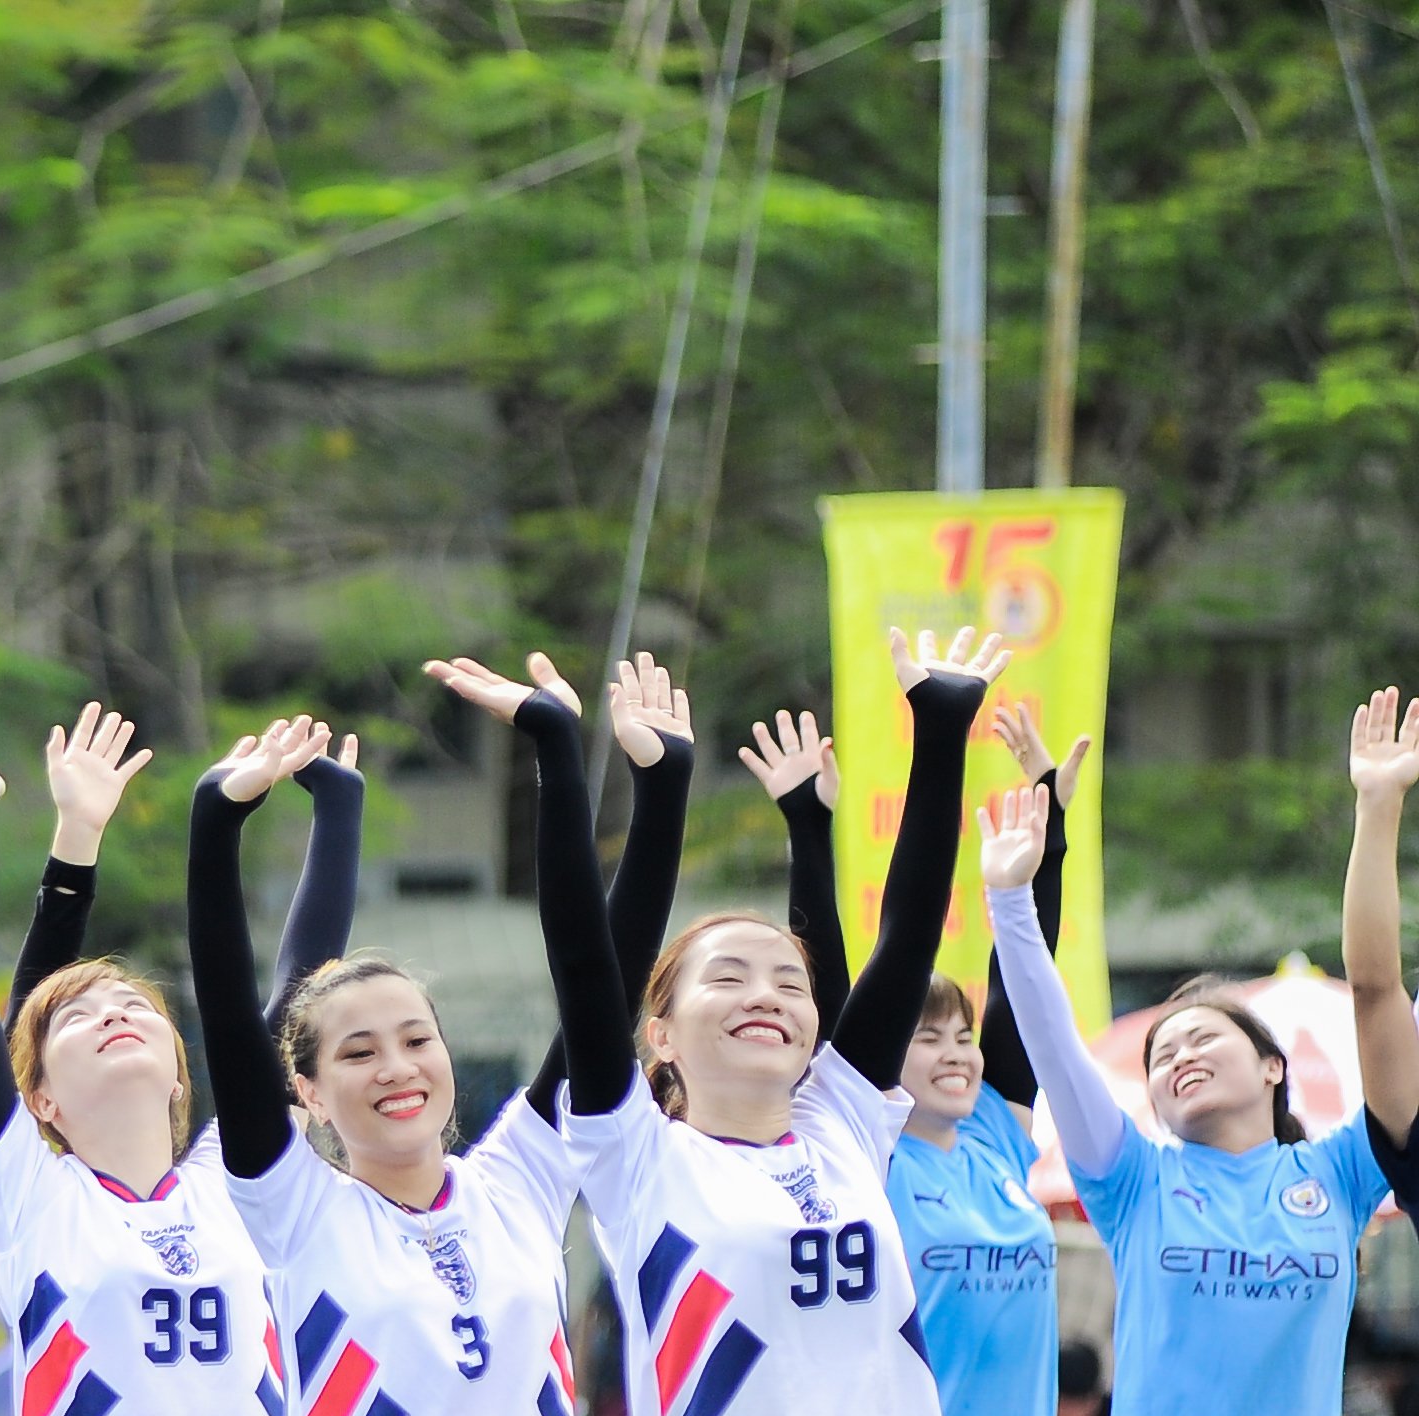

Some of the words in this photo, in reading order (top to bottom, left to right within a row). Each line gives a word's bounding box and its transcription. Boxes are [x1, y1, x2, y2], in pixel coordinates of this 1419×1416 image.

[790, 1219, 880, 1311] 99
[1160, 1247, 1340, 1279] ETIHAD
[1193, 1281, 1312, 1300] AIRWAYS
[142, 1286, 233, 1367] 39
[452, 1313, 491, 1383] 3
